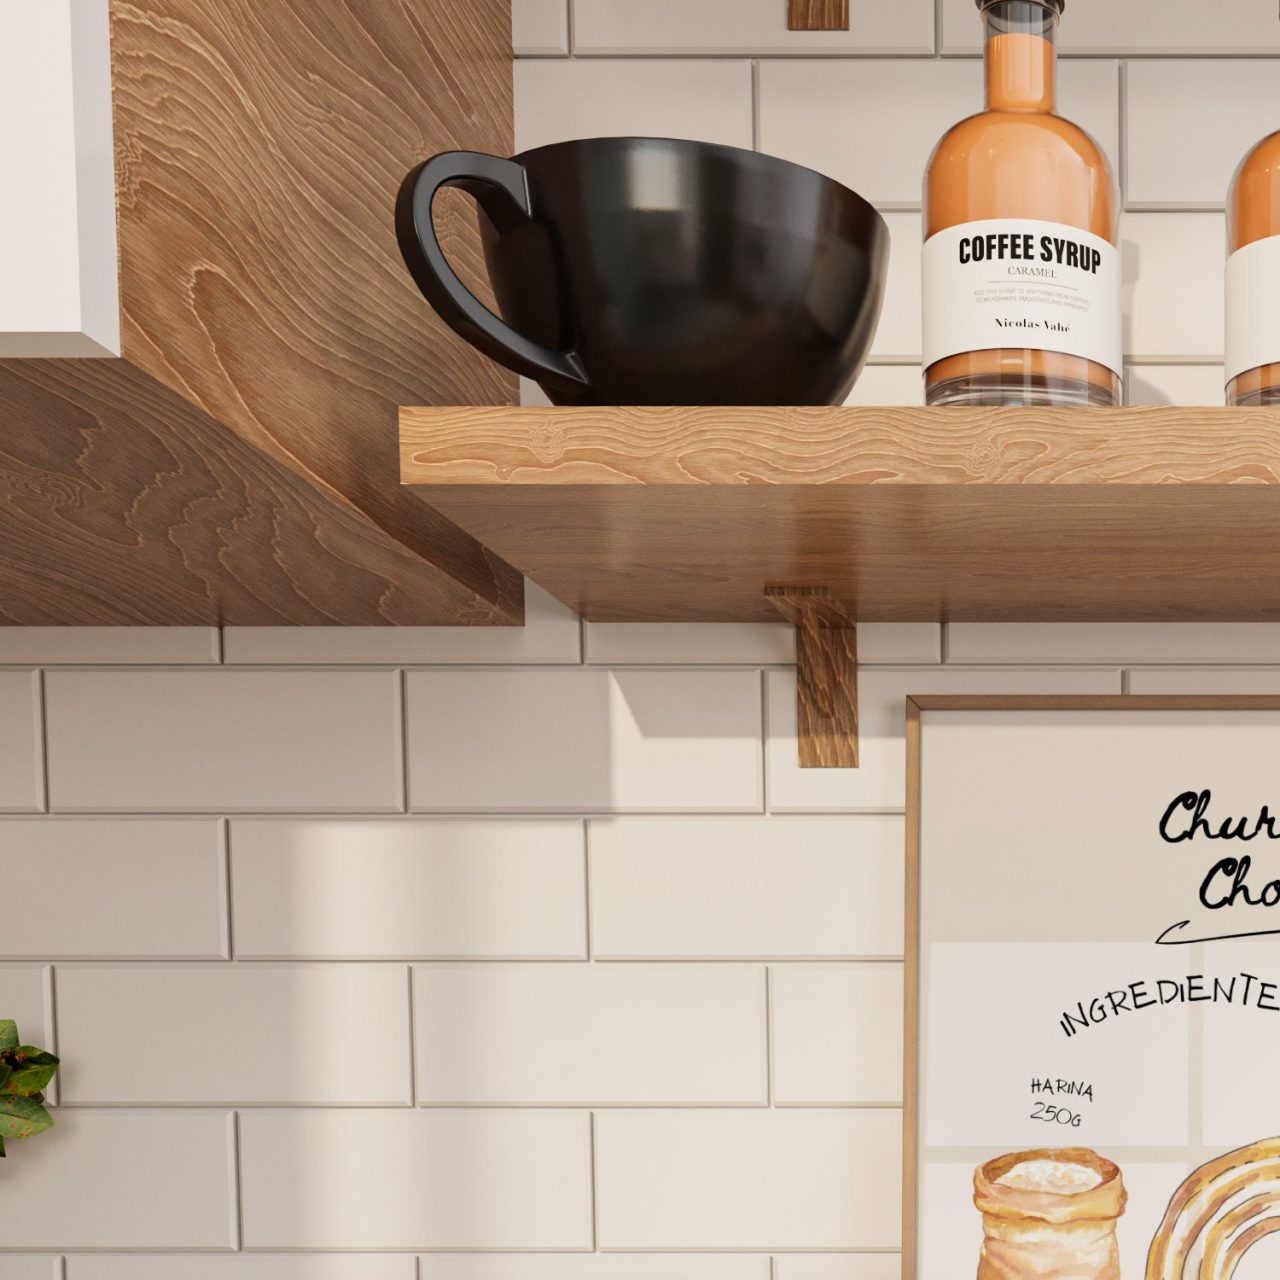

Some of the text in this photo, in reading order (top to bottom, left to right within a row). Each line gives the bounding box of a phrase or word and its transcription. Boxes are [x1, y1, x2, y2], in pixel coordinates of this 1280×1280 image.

[959, 233, 1101, 274] COFFEE SYRUP
[1007, 266, 1057, 279] CARAMEL
[995, 318, 1040, 329] Nicolas
[1030, 1077, 1094, 1103] HARINA
[1030, 1101, 1082, 1127] 250G
